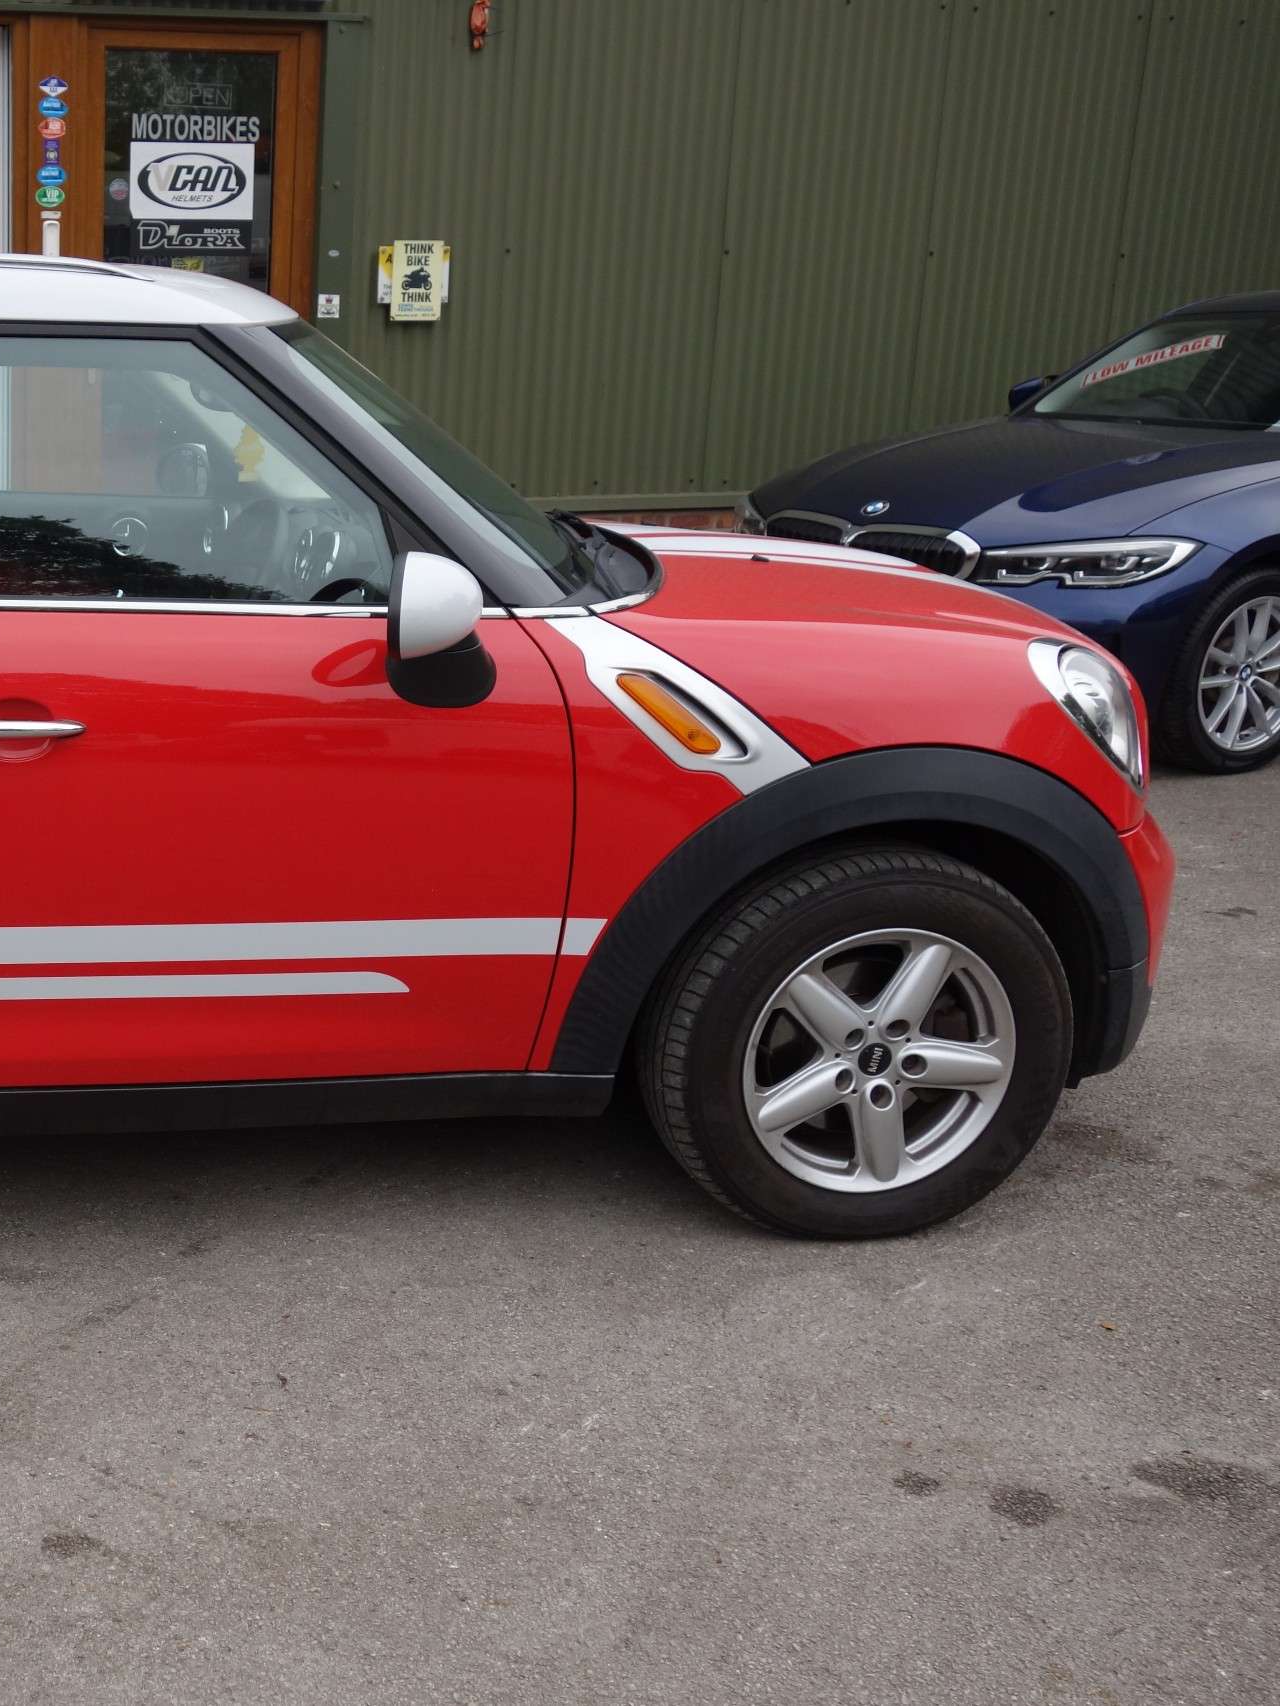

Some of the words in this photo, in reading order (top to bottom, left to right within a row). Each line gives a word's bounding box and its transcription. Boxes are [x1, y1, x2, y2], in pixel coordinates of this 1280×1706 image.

[132, 113, 260, 142] MOTORBIKES
[171, 194, 214, 203] HELMETS
[404, 243, 434, 254] THINK
[406, 255, 430, 266] BIKE
[401, 291, 431, 303] THINK
[1091, 361, 1129, 381] LOW
[1135, 336, 1213, 366] MILEAGE
[867, 1047, 884, 1073] MINI
